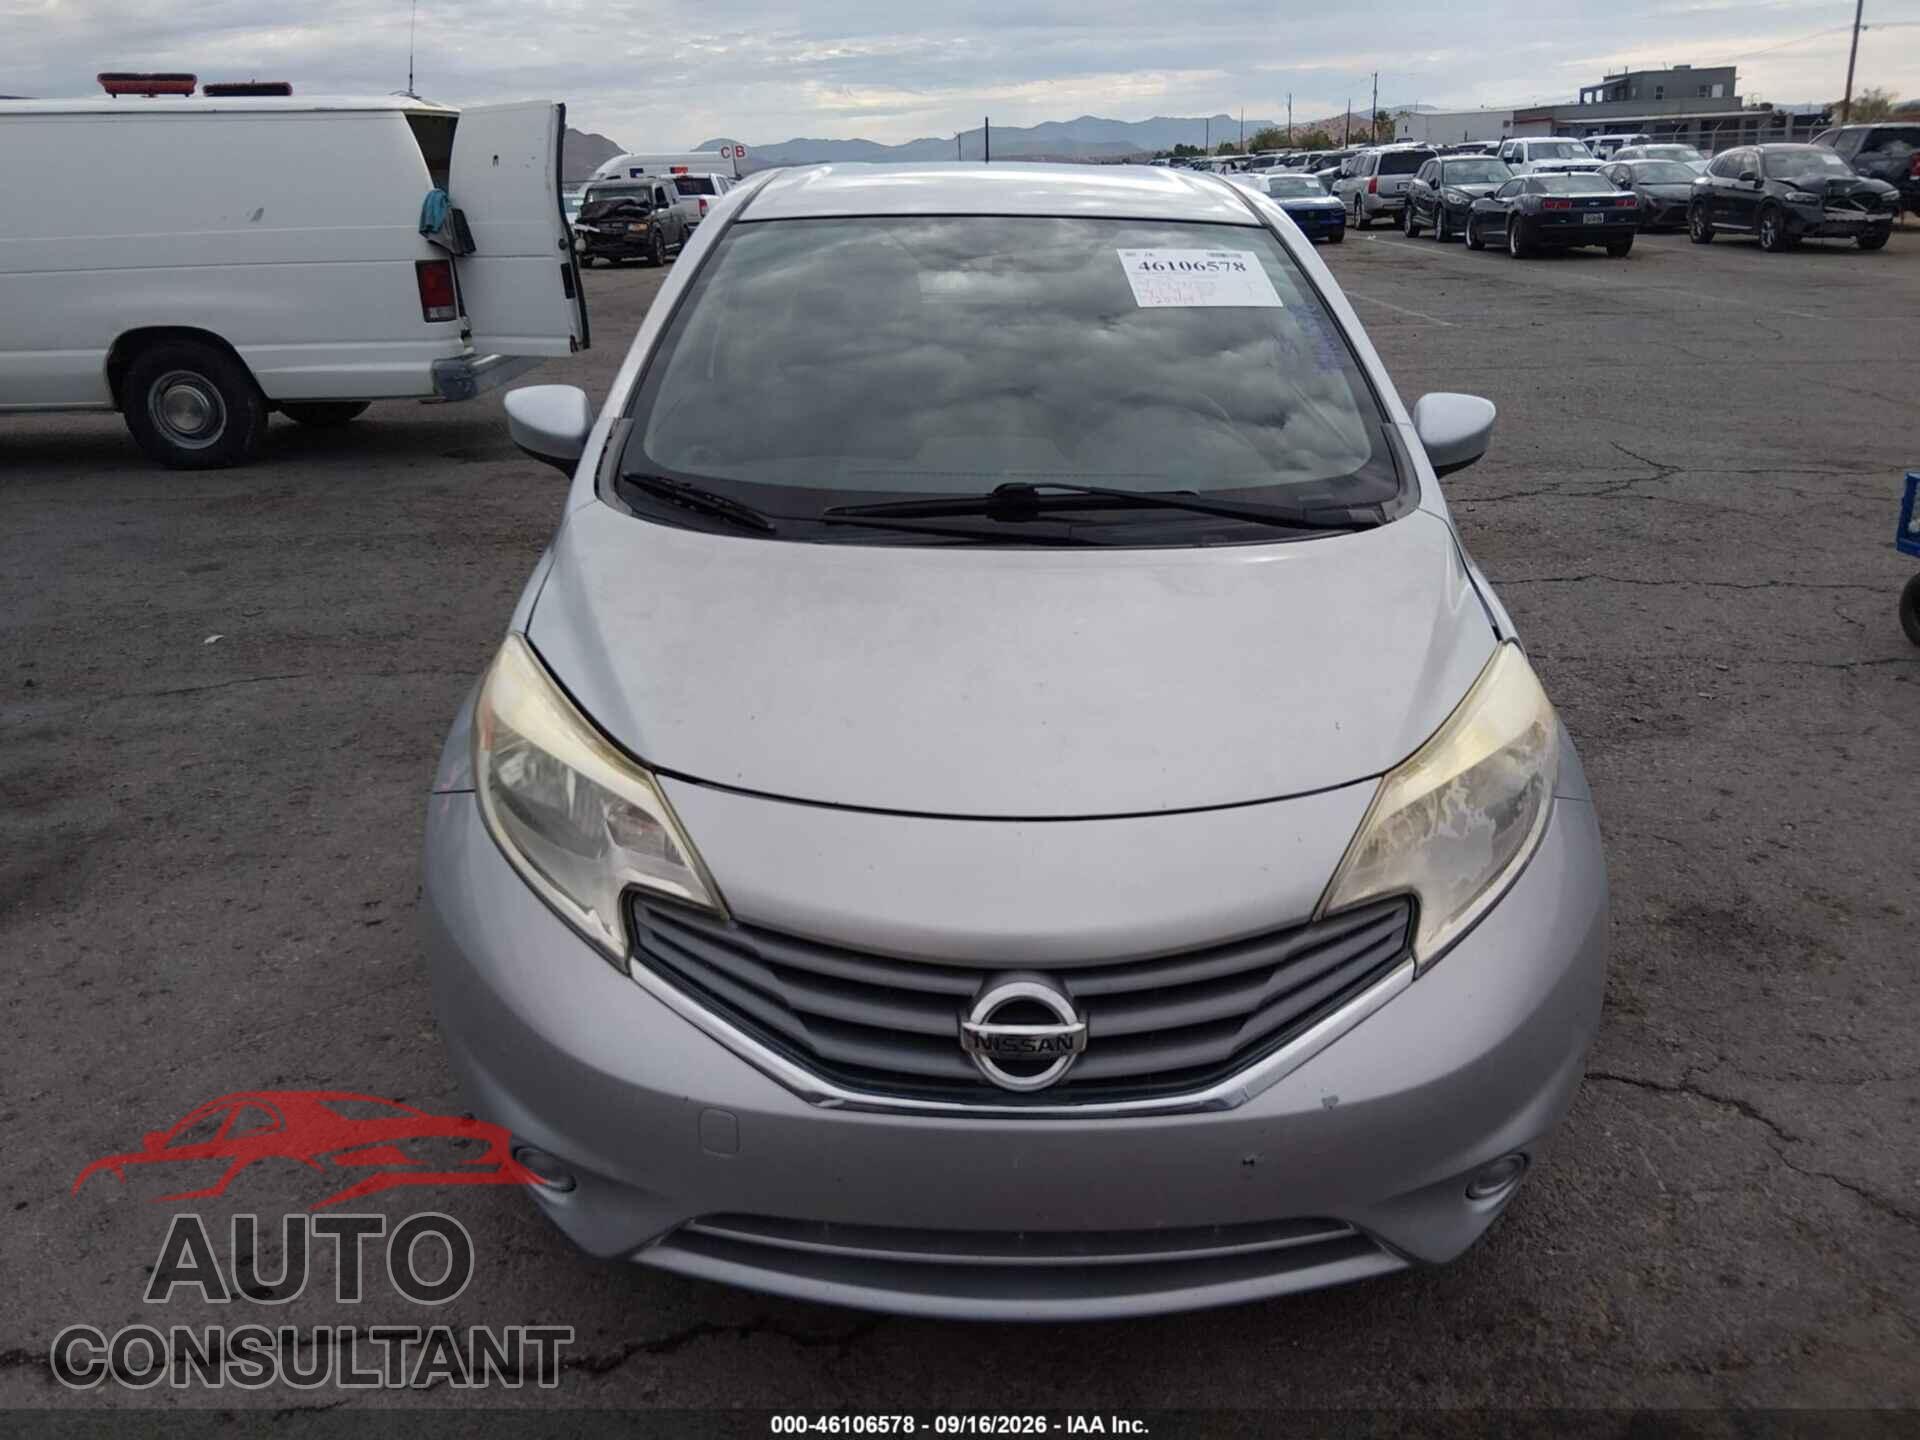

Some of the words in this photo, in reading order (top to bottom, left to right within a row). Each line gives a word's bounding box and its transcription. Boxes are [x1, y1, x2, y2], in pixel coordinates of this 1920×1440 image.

[720, 146, 731, 159] C
[735, 145, 746, 158] B
[1138, 260, 1247, 272] 46106578
[974, 1034, 1073, 1053] NISSAN
